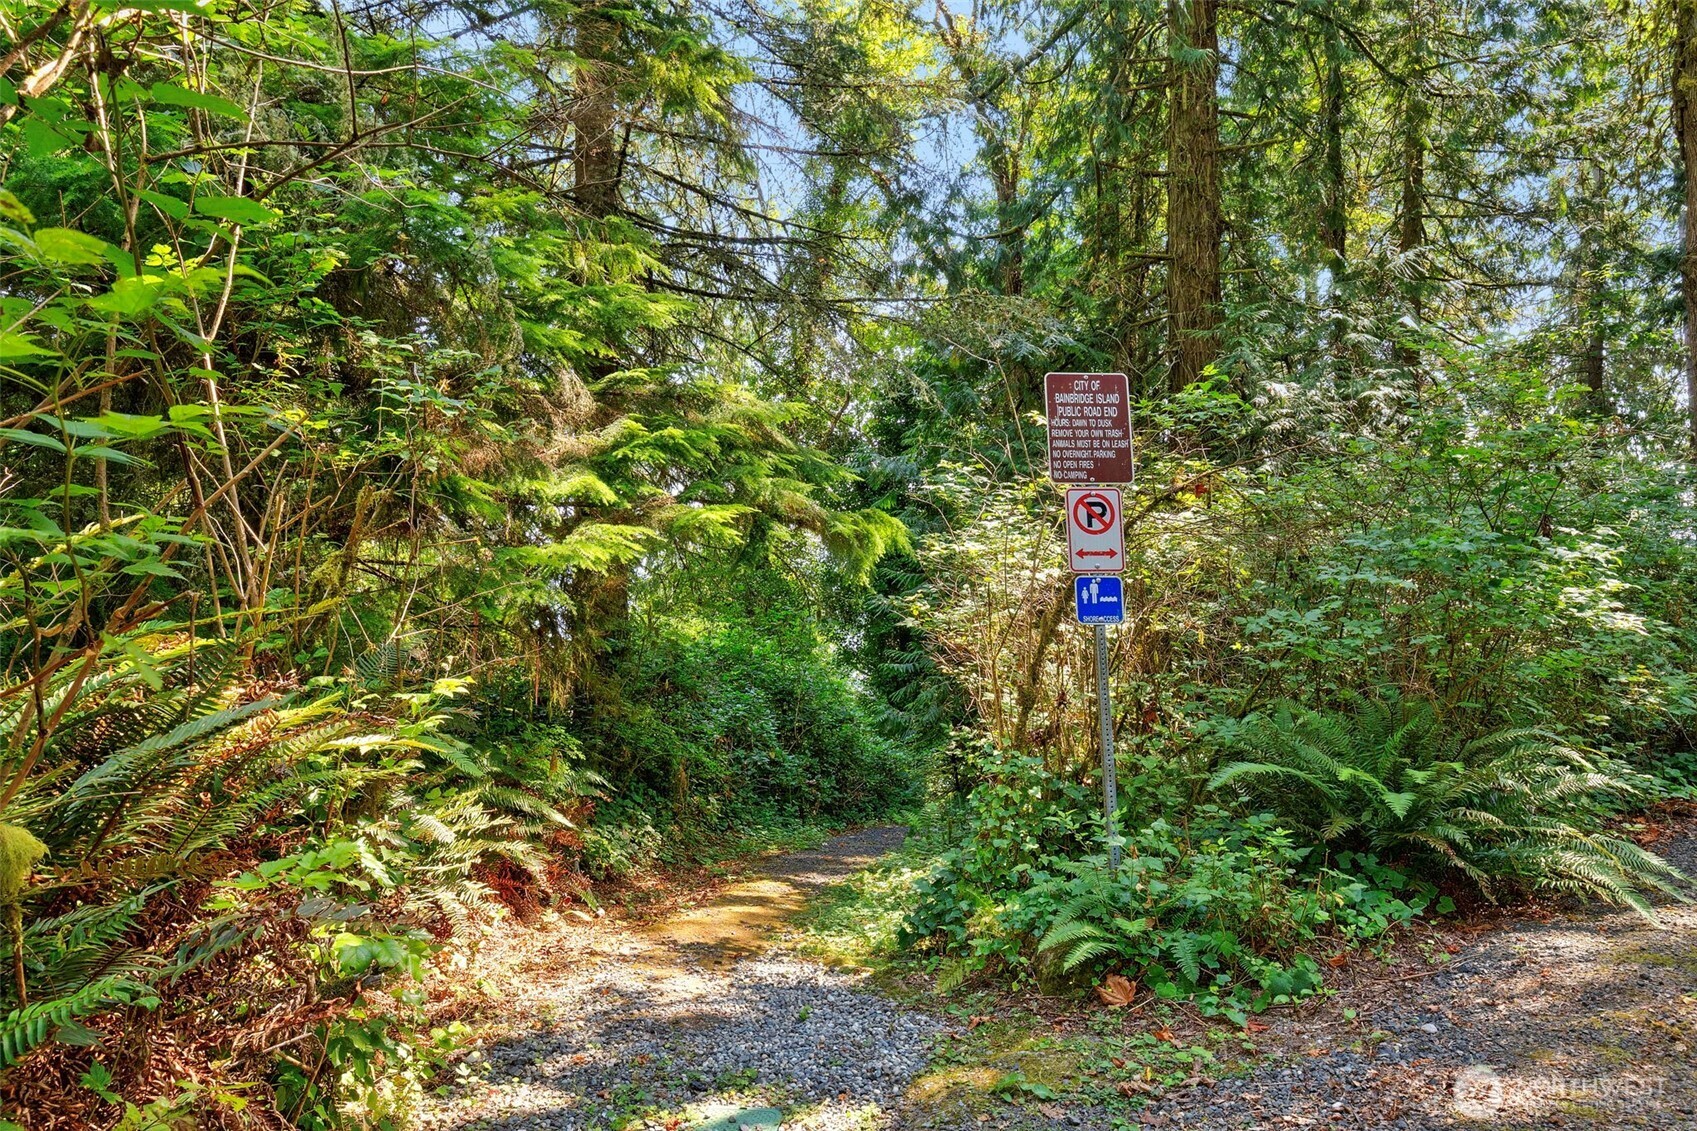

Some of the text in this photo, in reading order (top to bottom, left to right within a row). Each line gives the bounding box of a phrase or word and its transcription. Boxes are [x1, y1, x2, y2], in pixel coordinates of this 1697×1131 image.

[1073, 380, 1100, 391] CITY OF
[1055, 393, 1120, 404] BAINBRIDGE ISLAND
[1058, 406, 1118, 417] PUBLIC ROAD END
[1051, 419, 1112, 427] HOURS: DAWN TO DUSK
[1051, 429, 1123, 438] REMOVE YOUR OWN TRASH
[1052, 440, 1129, 448] ANIMALS MUST BE ON LEASH
[1053, 450, 1116, 458] NO OVERNIGHT PARKING
[1053, 460, 1094, 469] NO OPEN FIRES
[1053, 471, 1087, 479] NO CAMPING
